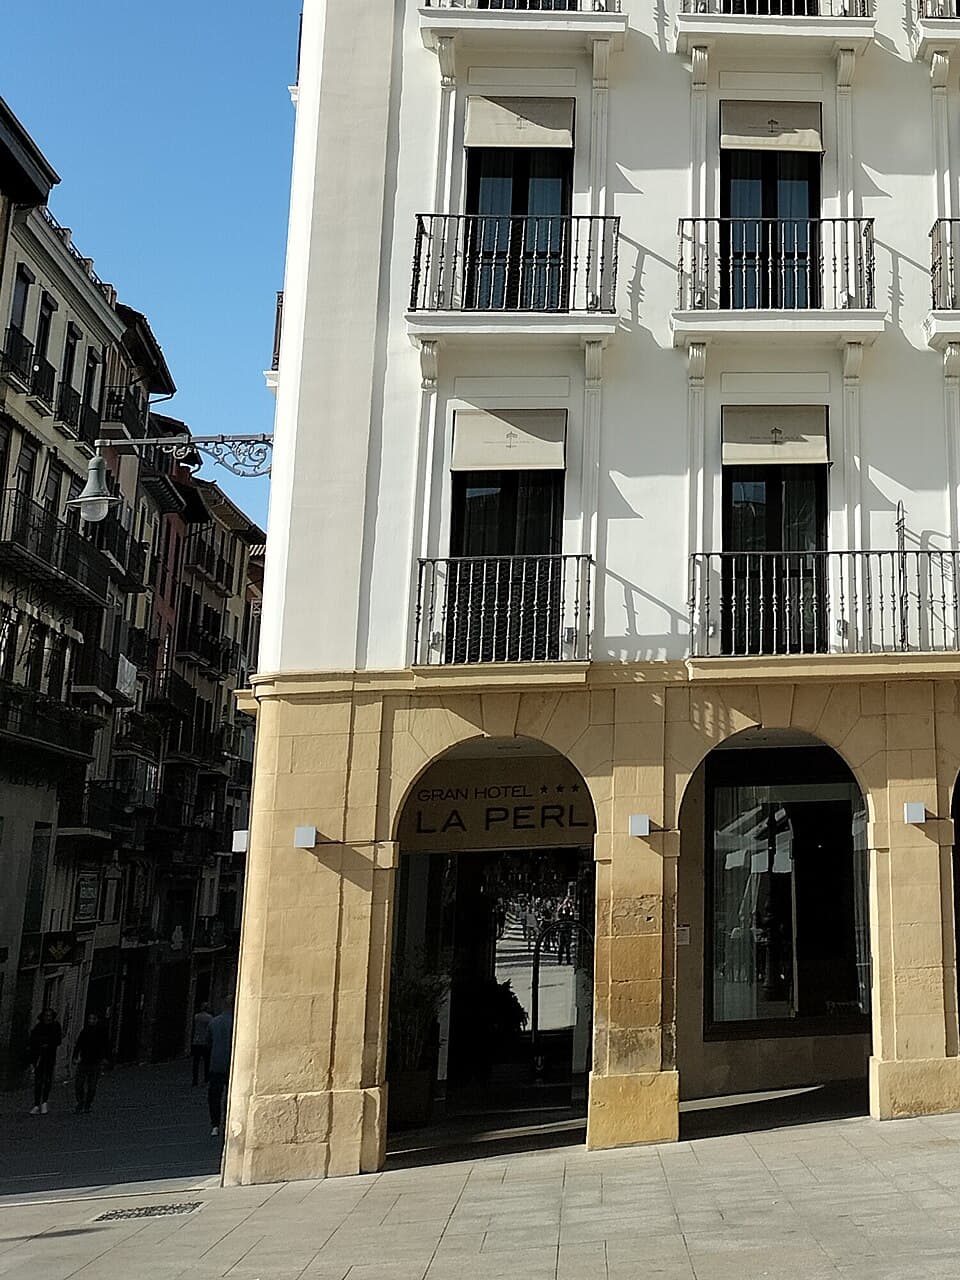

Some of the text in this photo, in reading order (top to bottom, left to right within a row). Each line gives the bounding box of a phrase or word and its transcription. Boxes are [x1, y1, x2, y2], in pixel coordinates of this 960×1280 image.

[417, 784, 533, 802] GRAN HOTEL
[416, 804, 595, 834] LA PERL
